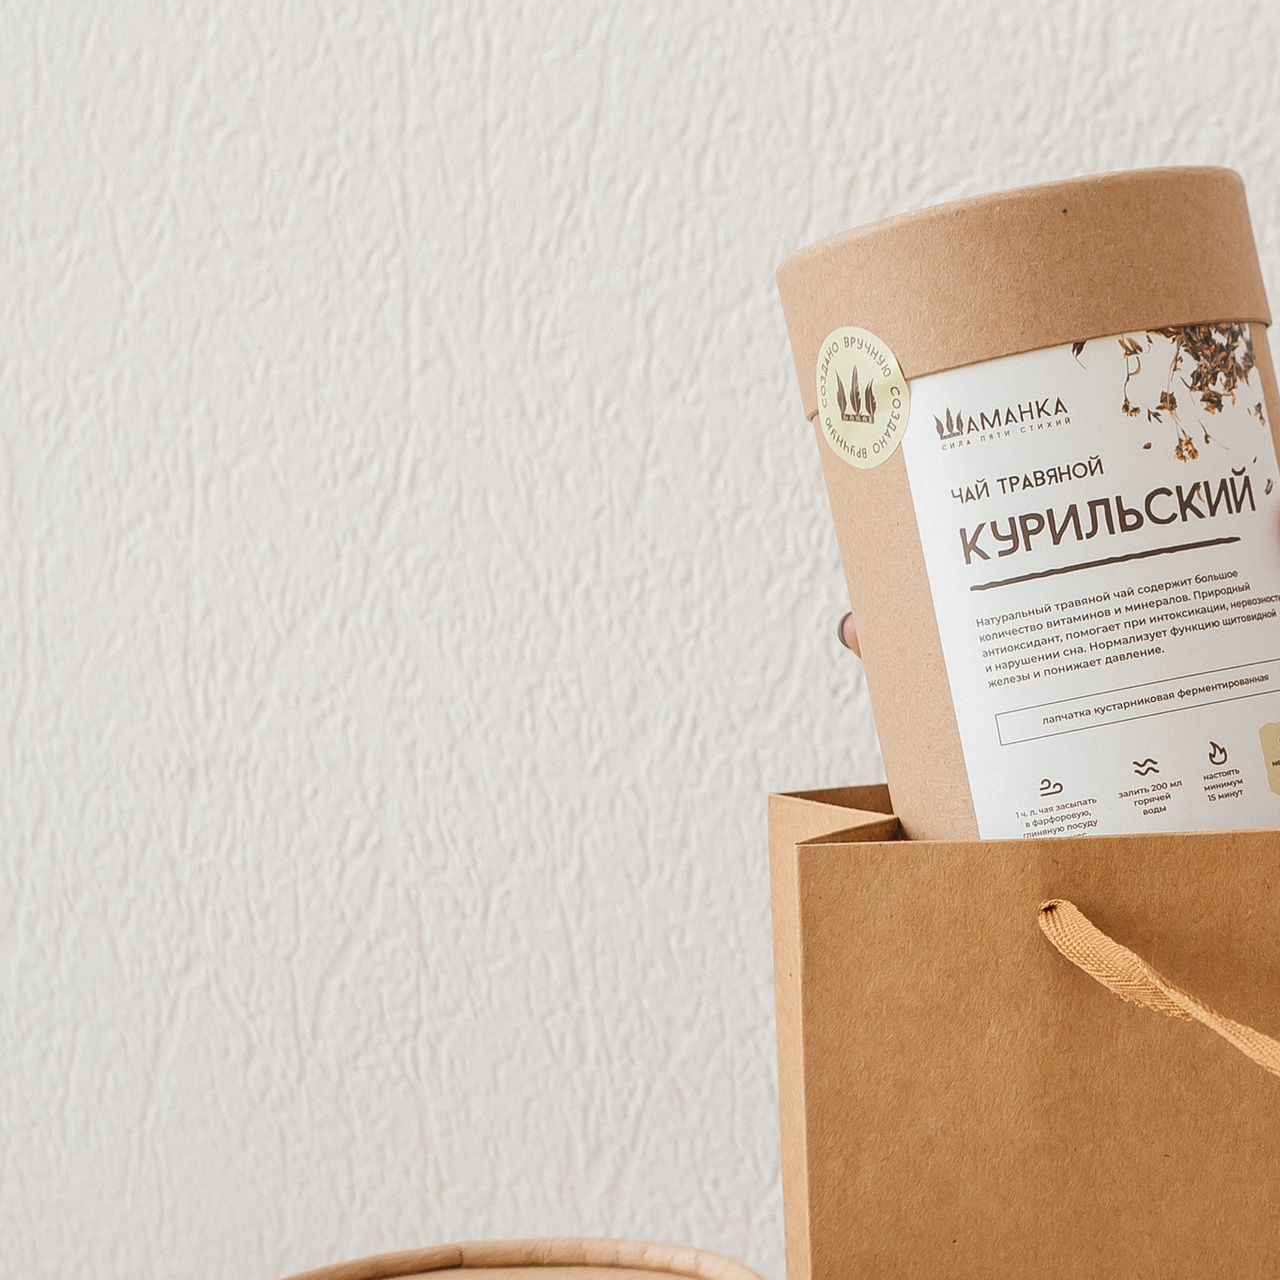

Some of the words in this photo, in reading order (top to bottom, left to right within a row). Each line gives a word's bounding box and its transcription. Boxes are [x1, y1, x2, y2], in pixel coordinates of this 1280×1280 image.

[820, 341, 839, 408] СОЗДАНО
[843, 336, 892, 378] ВРУЧНУЮ
[825, 417, 868, 459] ВРУЧНУЮ
[872, 385, 902, 454] СОЗДАНО
[941, 439, 972, 451] СИЛА
[980, 430, 1011, 443] ПЯТИ
[1020, 416, 1072, 434] СТИХИЙ
[951, 478, 990, 504] ЧАЙ
[996, 454, 1104, 494] ТРАВЯНОЙ
[959, 466, 1256, 565] КУРИЛЬСКИЙ
[976, 604, 1052, 628] Натуральный
[1054, 591, 1111, 612] травяной
[1113, 587, 1135, 600] чай
[1137, 577, 1193, 595] содержит
[1194, 570, 1238, 584] большое
[979, 622, 1044, 643] количество
[1046, 609, 1112, 629] витаминов
[1114, 606, 1122, 616] и
[1125, 595, 1191, 613] минералов.
[1193, 582, 1251, 601] Природный
[982, 635, 1063, 658] антиоксидант,
[1065, 622, 1121, 641] помогает
[1123, 618, 1147, 630] при
[1149, 602, 1229, 624] интоксикации,
[985, 665, 993, 673] и
[995, 651, 1060, 672] нарушении
[1063, 647, 1087, 657] сна.
[1089, 629, 1167, 652] Нормализует
[1170, 619, 1220, 638] функцию
[1222, 609, 1277, 627] щитовидной
[988, 672, 1031, 689] железы
[1033, 670, 1041, 679] и
[1043, 658, 1102, 678] понижает
[1104, 646, 1165, 665] давление.
[1042, 708, 1092, 725] лапчатка
[1094, 692, 1175, 715] кустарниковая
[1177, 673, 1270, 699] ферментированная
[1118, 786, 1149, 799] залить
[1151, 782, 1168, 793] 200
[1169, 779, 1183, 788] мл
[1203, 768, 1240, 781] настоять
[1203, 778, 1243, 792] минимум
[1207, 793, 1217, 802] 15
[1218, 789, 1244, 801] минут
[1032, 810, 1092, 827] фарфоровую,
[1038, 806, 1054, 814] чая
[1055, 798, 1098, 811] засыпать
[1134, 792, 1172, 807] горячей
[1142, 804, 1167, 816] воды
[1067, 819, 1098, 831] посуду
